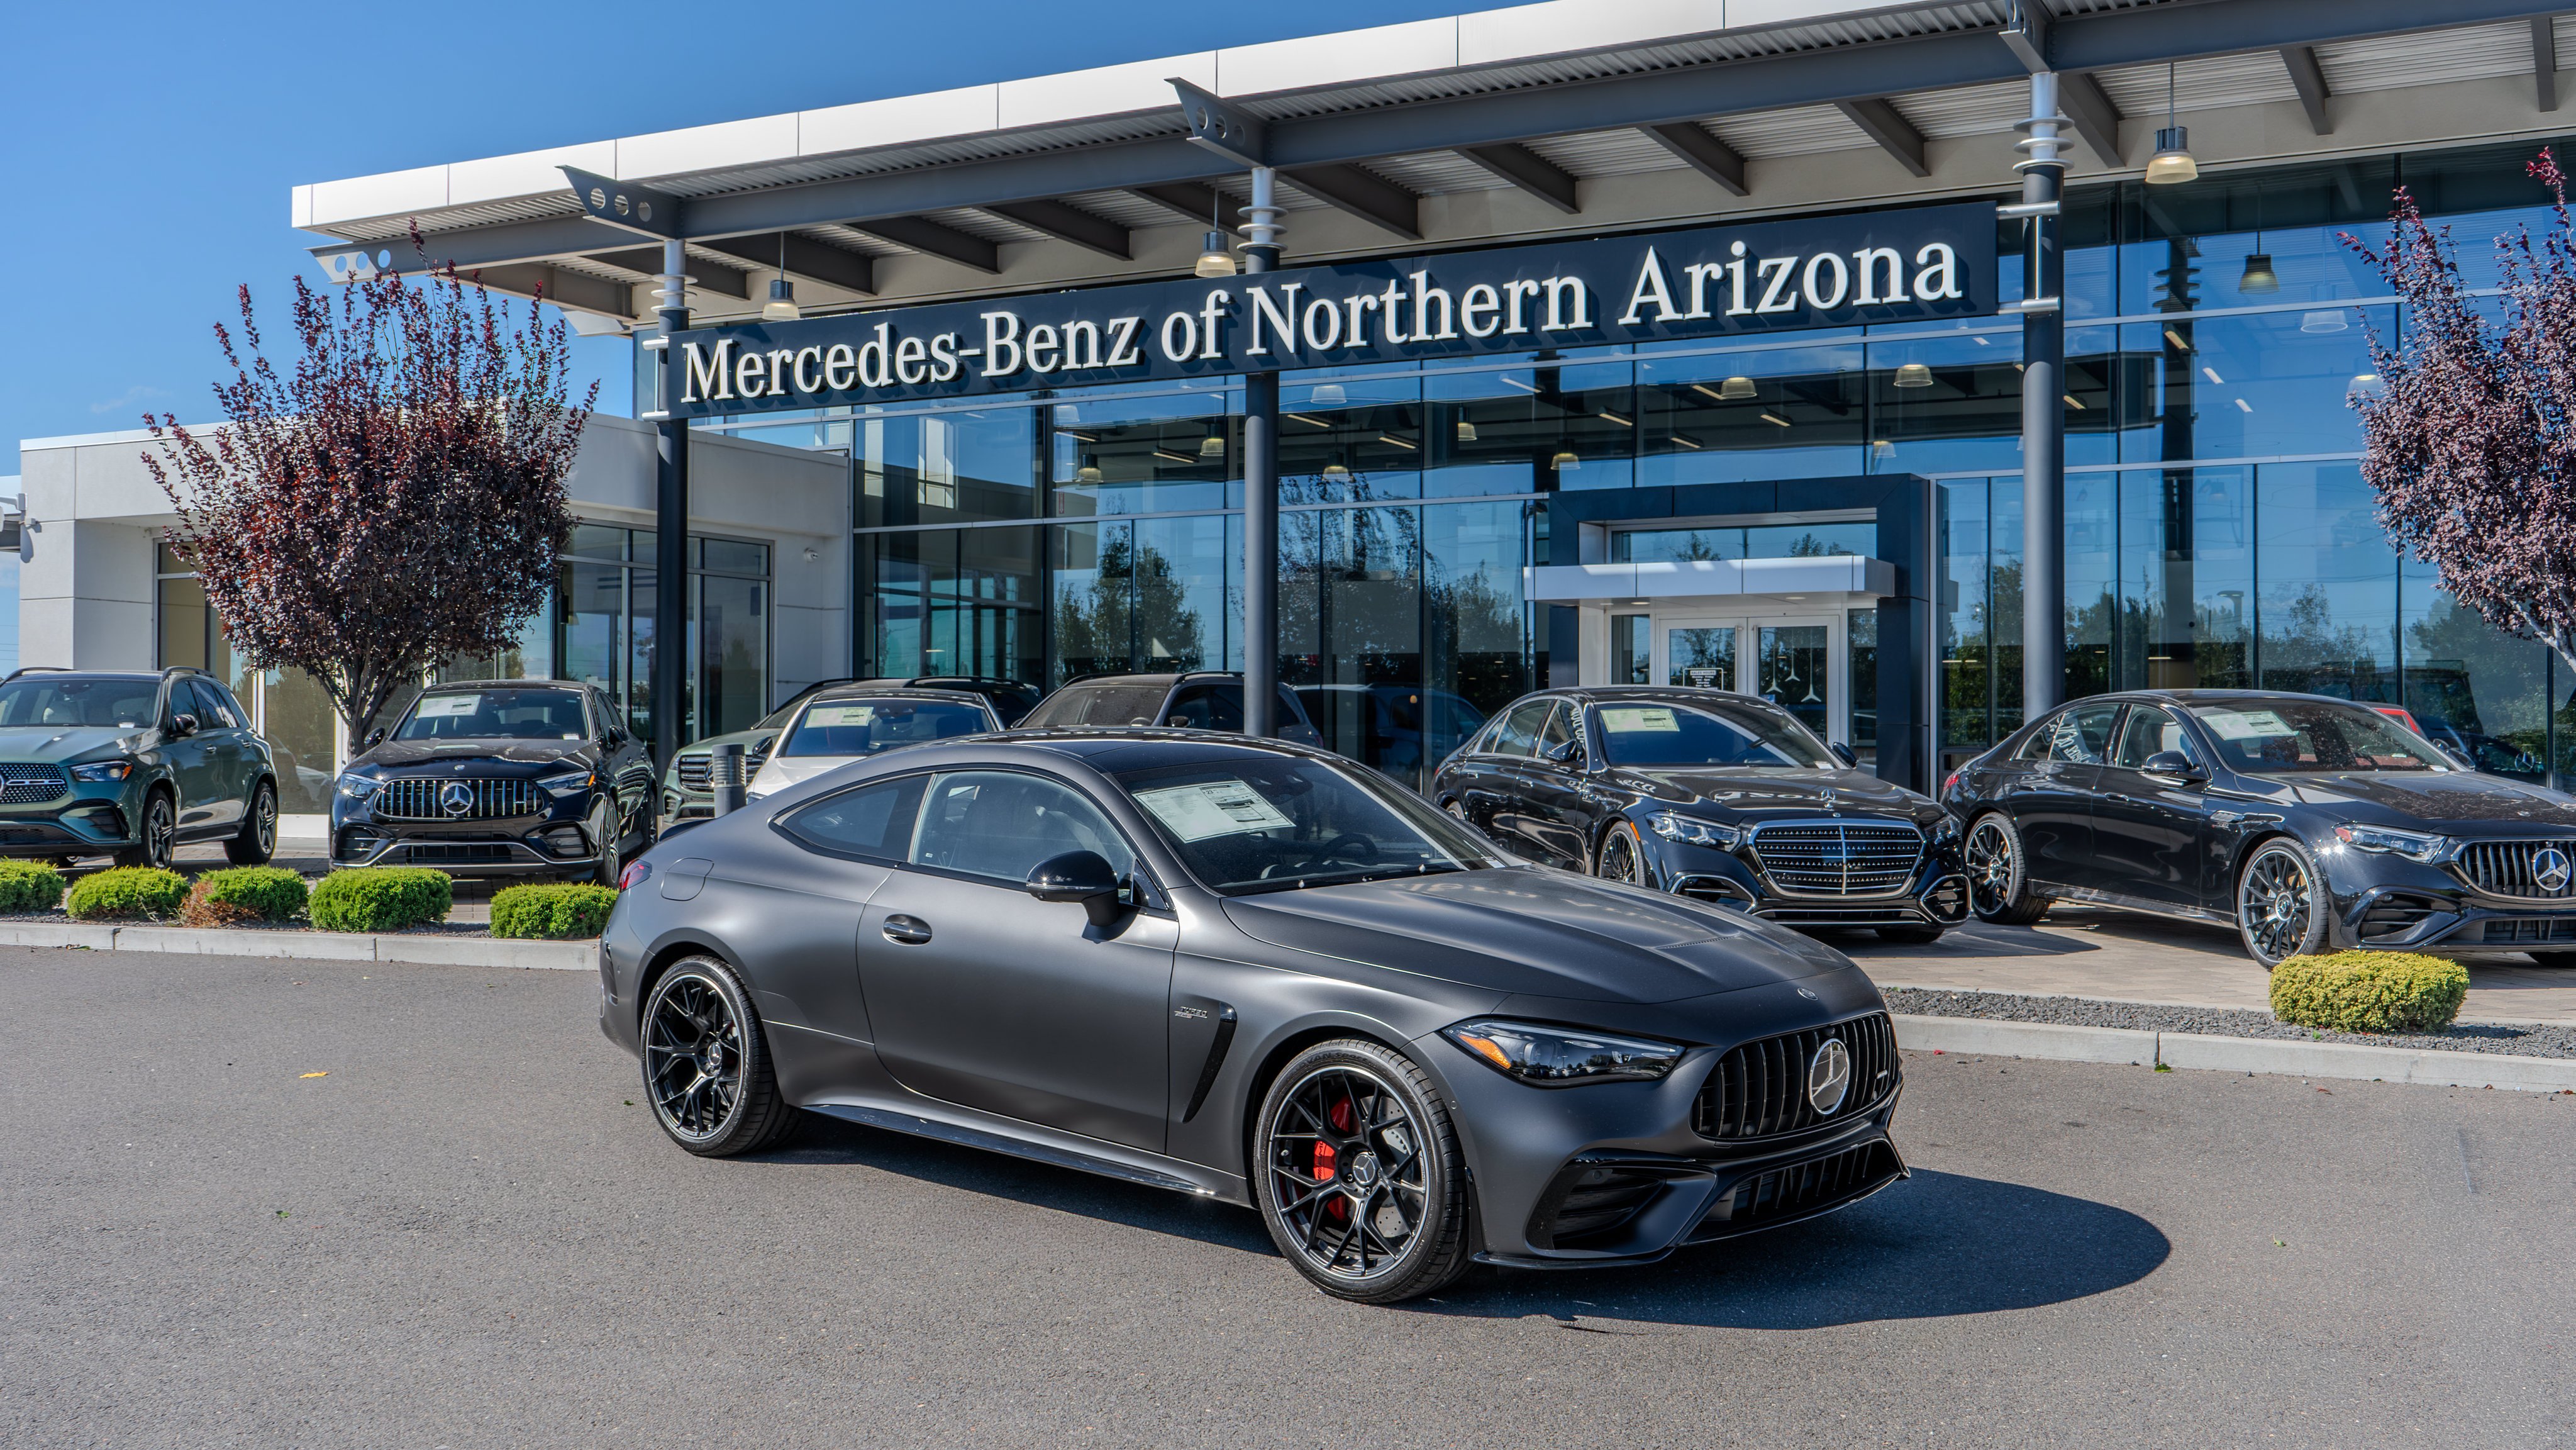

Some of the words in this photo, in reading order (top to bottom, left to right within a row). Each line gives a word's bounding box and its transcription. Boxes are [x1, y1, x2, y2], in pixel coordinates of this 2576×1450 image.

[681, 312, 1140, 403] Mercedes-Benz
[1162, 290, 1228, 360] of
[1246, 270, 1592, 354] Northern
[1619, 242, 1962, 324] Arizona
